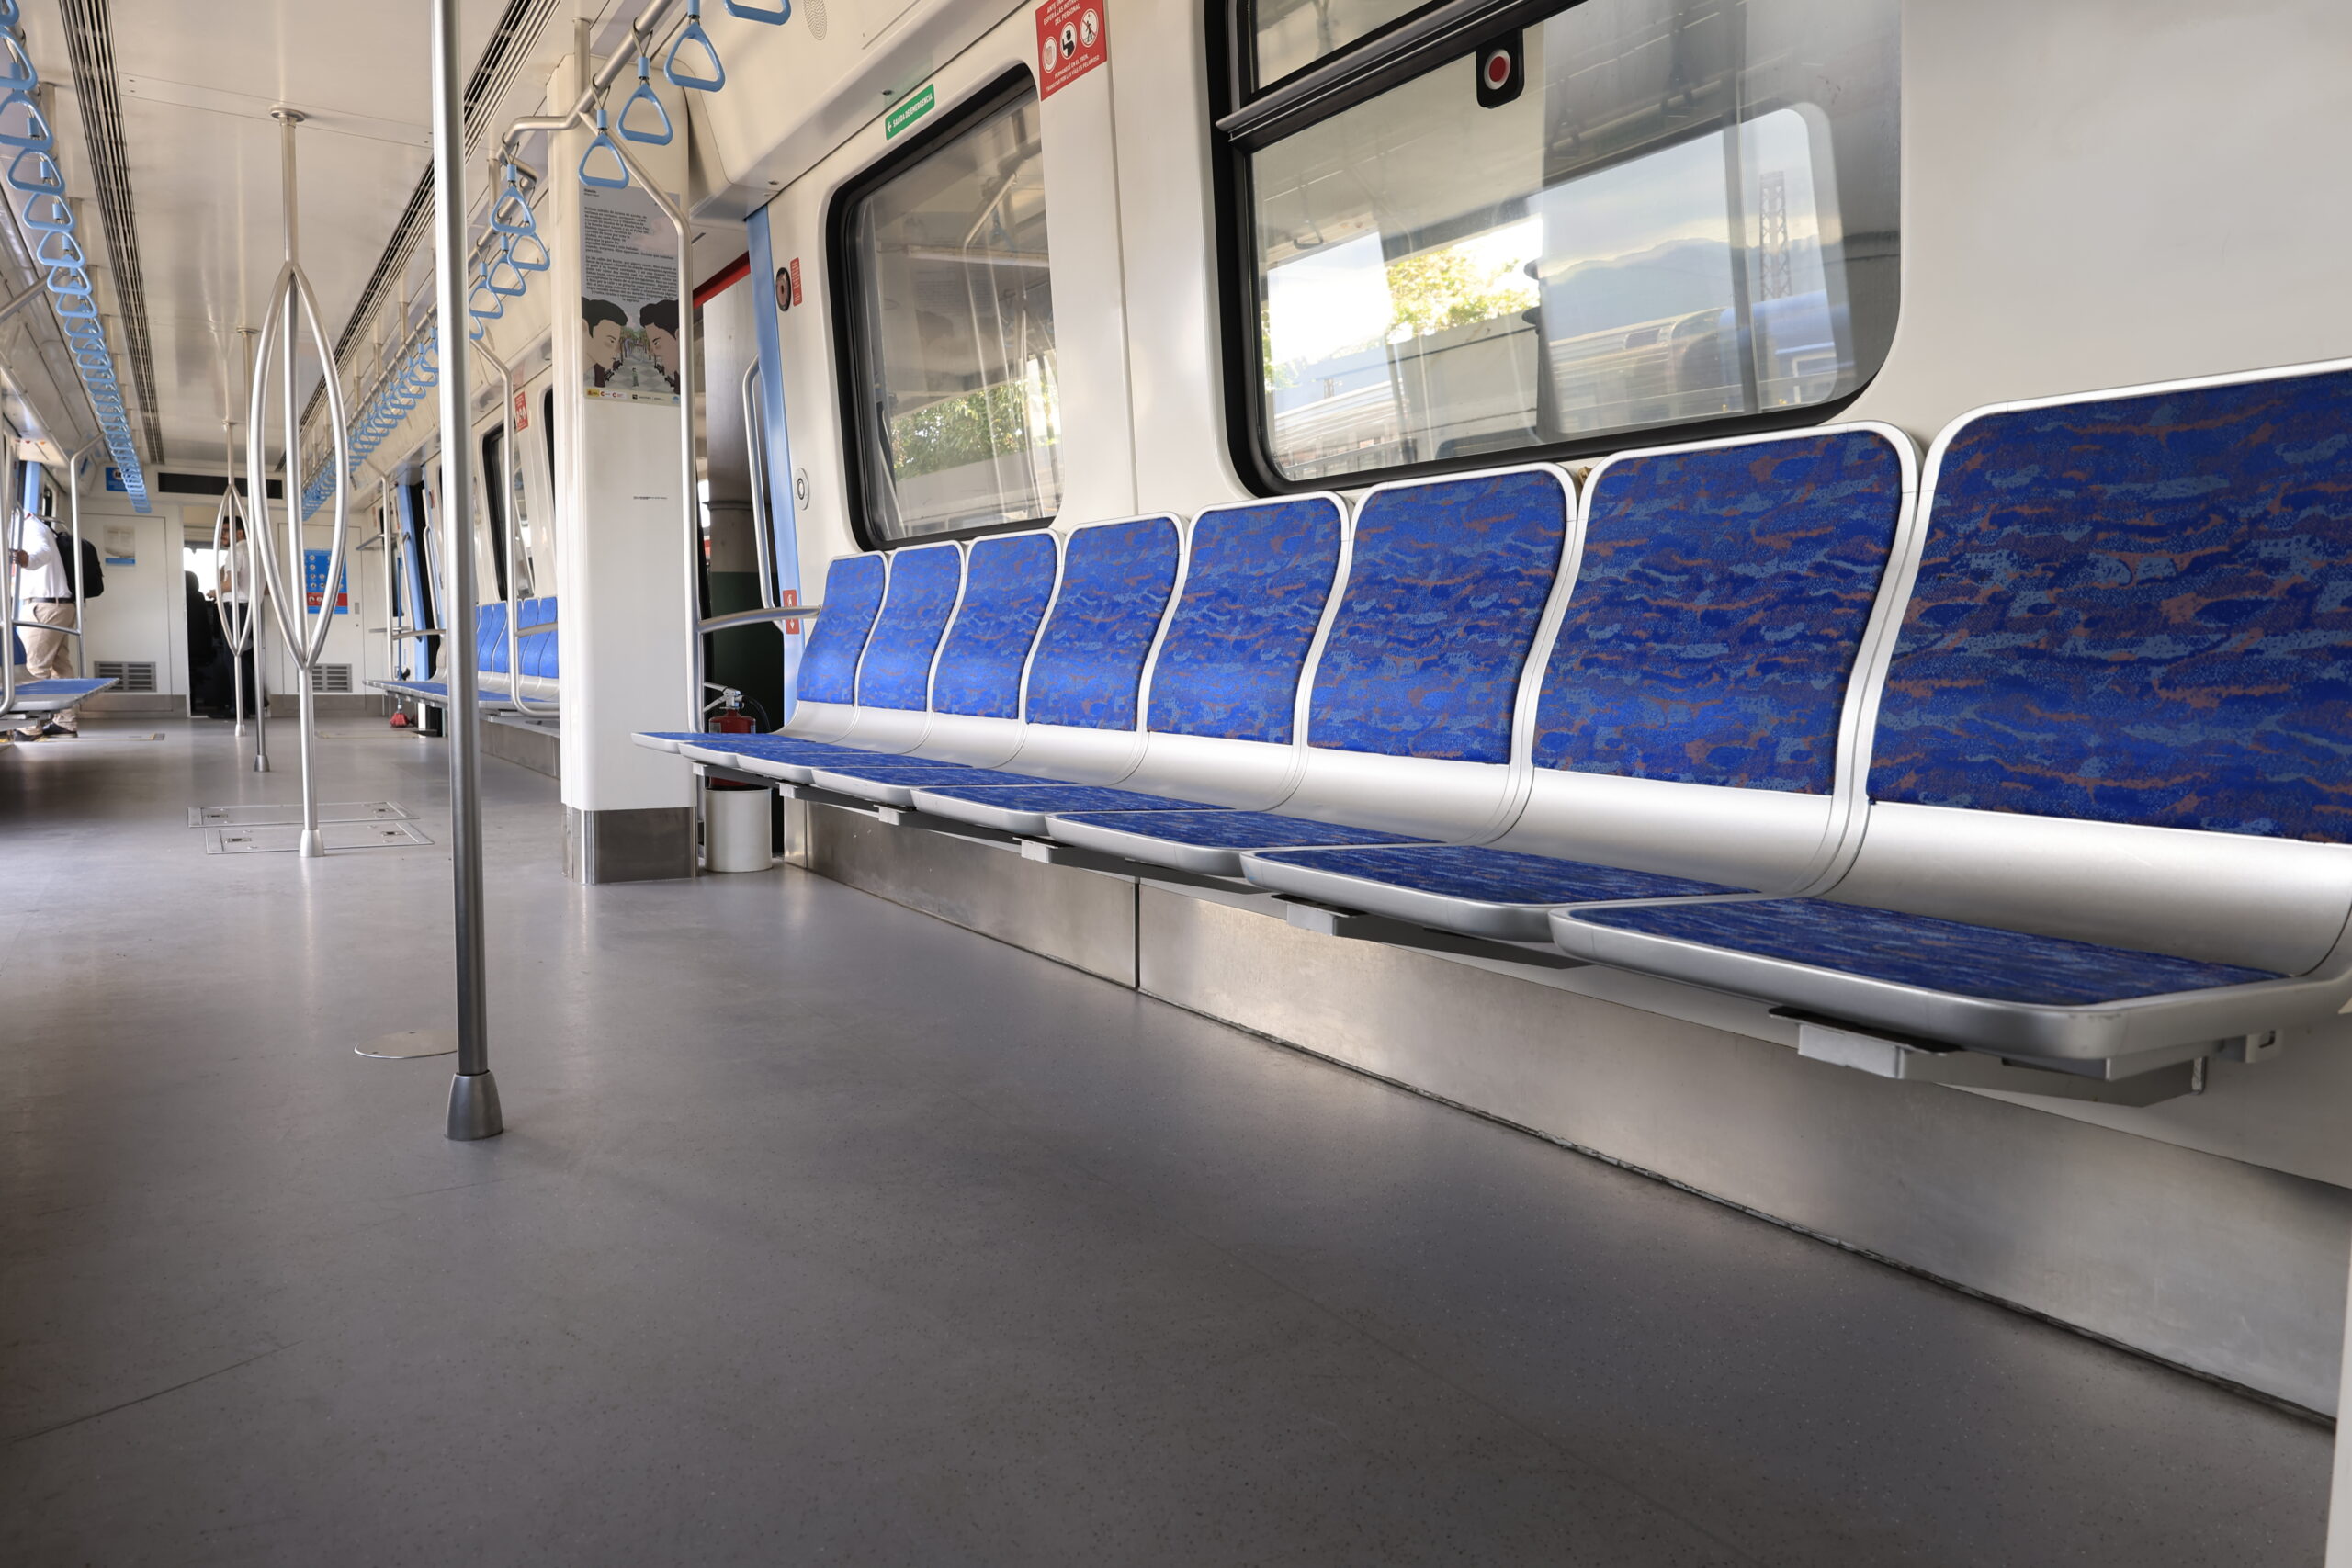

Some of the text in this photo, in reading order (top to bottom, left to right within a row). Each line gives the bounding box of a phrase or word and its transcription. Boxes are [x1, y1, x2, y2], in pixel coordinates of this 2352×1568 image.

[1062, 3, 1080, 19] PERSONAL
[893, 114, 905, 127] SALIDA
[910, 94, 933, 115] EMERGENCIA
